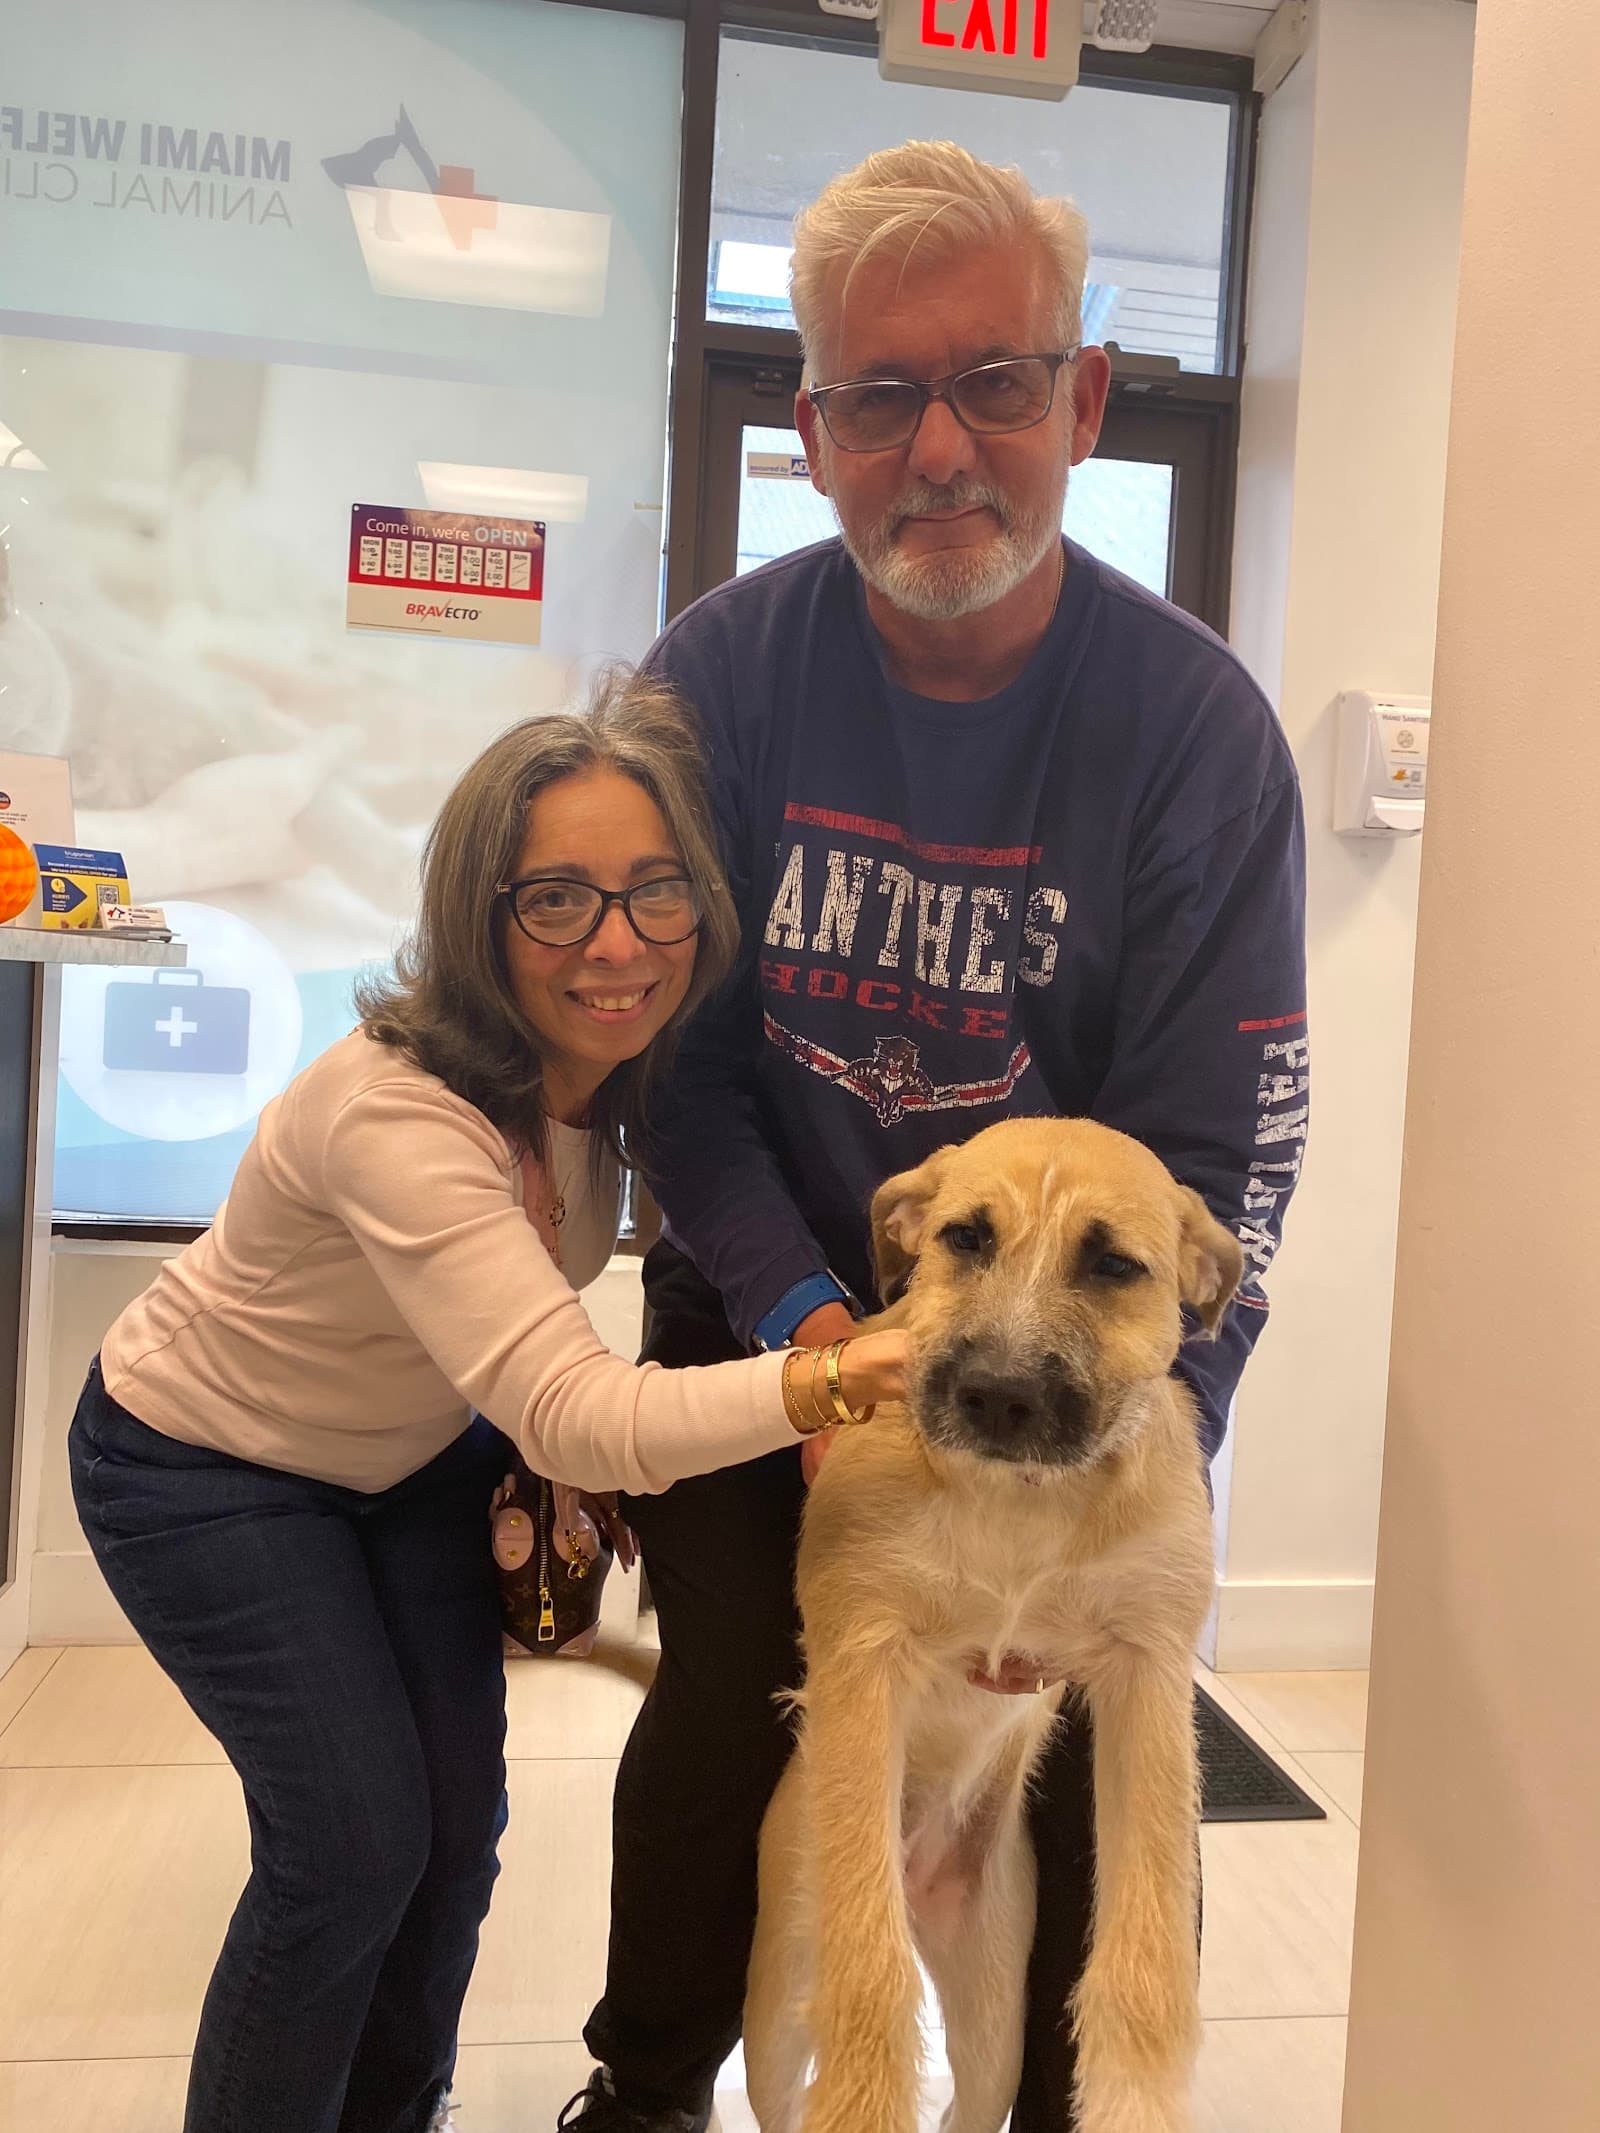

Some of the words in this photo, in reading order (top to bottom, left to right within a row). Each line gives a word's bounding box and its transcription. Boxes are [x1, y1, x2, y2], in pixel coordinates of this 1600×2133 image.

[791, 460, 808, 475] AD
[366, 518, 409, 535] Come
[412, 523, 429, 539] in,
[432, 527, 470, 543] we're
[474, 526, 528, 547] OPEN
[406, 600, 479, 621] BRAVECTO
[763, 843, 1069, 994] ANTHES
[760, 958, 1009, 1040] HOCKE
